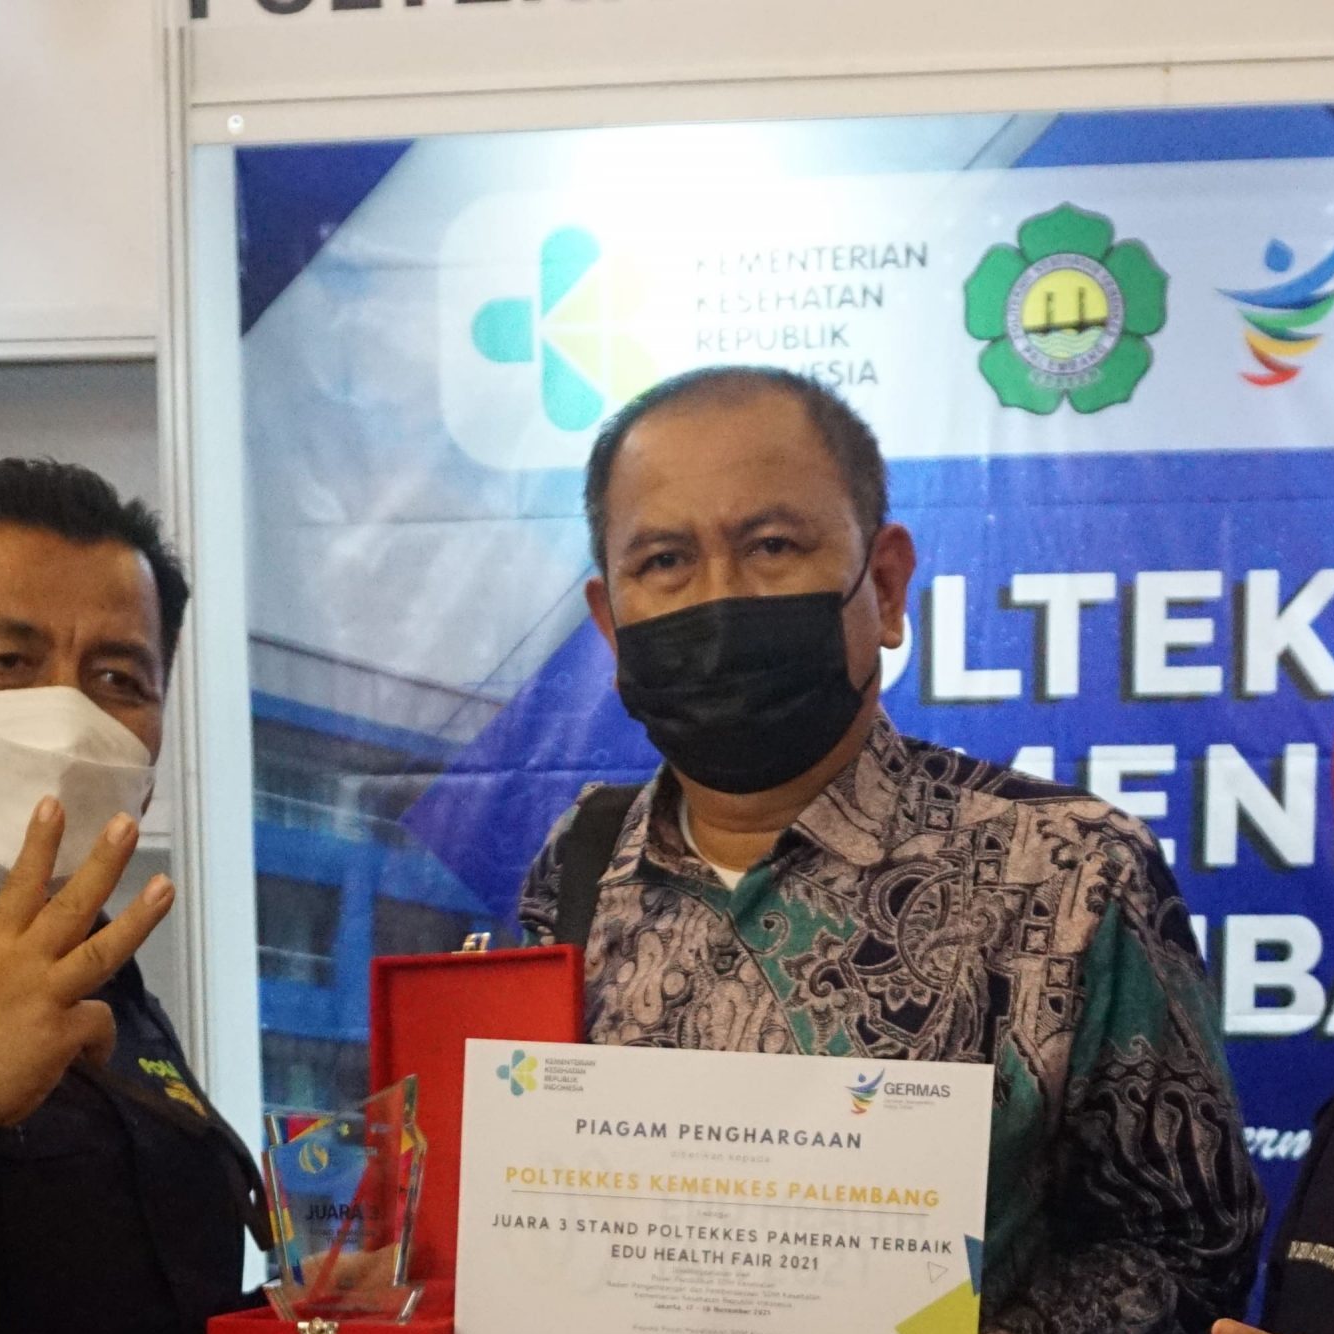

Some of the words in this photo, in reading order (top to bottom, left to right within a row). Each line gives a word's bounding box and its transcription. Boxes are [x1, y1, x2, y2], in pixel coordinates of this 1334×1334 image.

[696, 241, 928, 275] KEMENTERIAN
[696, 282, 885, 314] KESEHATAN
[696, 322, 851, 353] REPUBLIK
[883, 1081, 952, 1099] GERMAS
[575, 1118, 669, 1140] PIAGAM
[678, 1123, 864, 1150] PENGHARGAAN
[505, 1165, 640, 1192] POLTEKKES
[649, 1173, 779, 1200] KEMENKES
[788, 1181, 942, 1209] PALEMBANG
[306, 1203, 363, 1221] JUARA
[491, 1213, 551, 1231] JUARA
[558, 1217, 568, 1232] 3
[575, 1218, 640, 1237] STAND
[647, 1223, 759, 1244] POLTEKKES
[767, 1230, 861, 1250] PAMERAN
[869, 1235, 954, 1255] TERBAIK
[610, 1244, 648, 1261] EDU
[653, 1246, 725, 1267] HEALTH
[730, 1250, 773, 1269] FAIR
[779, 1254, 820, 1272] 2021
